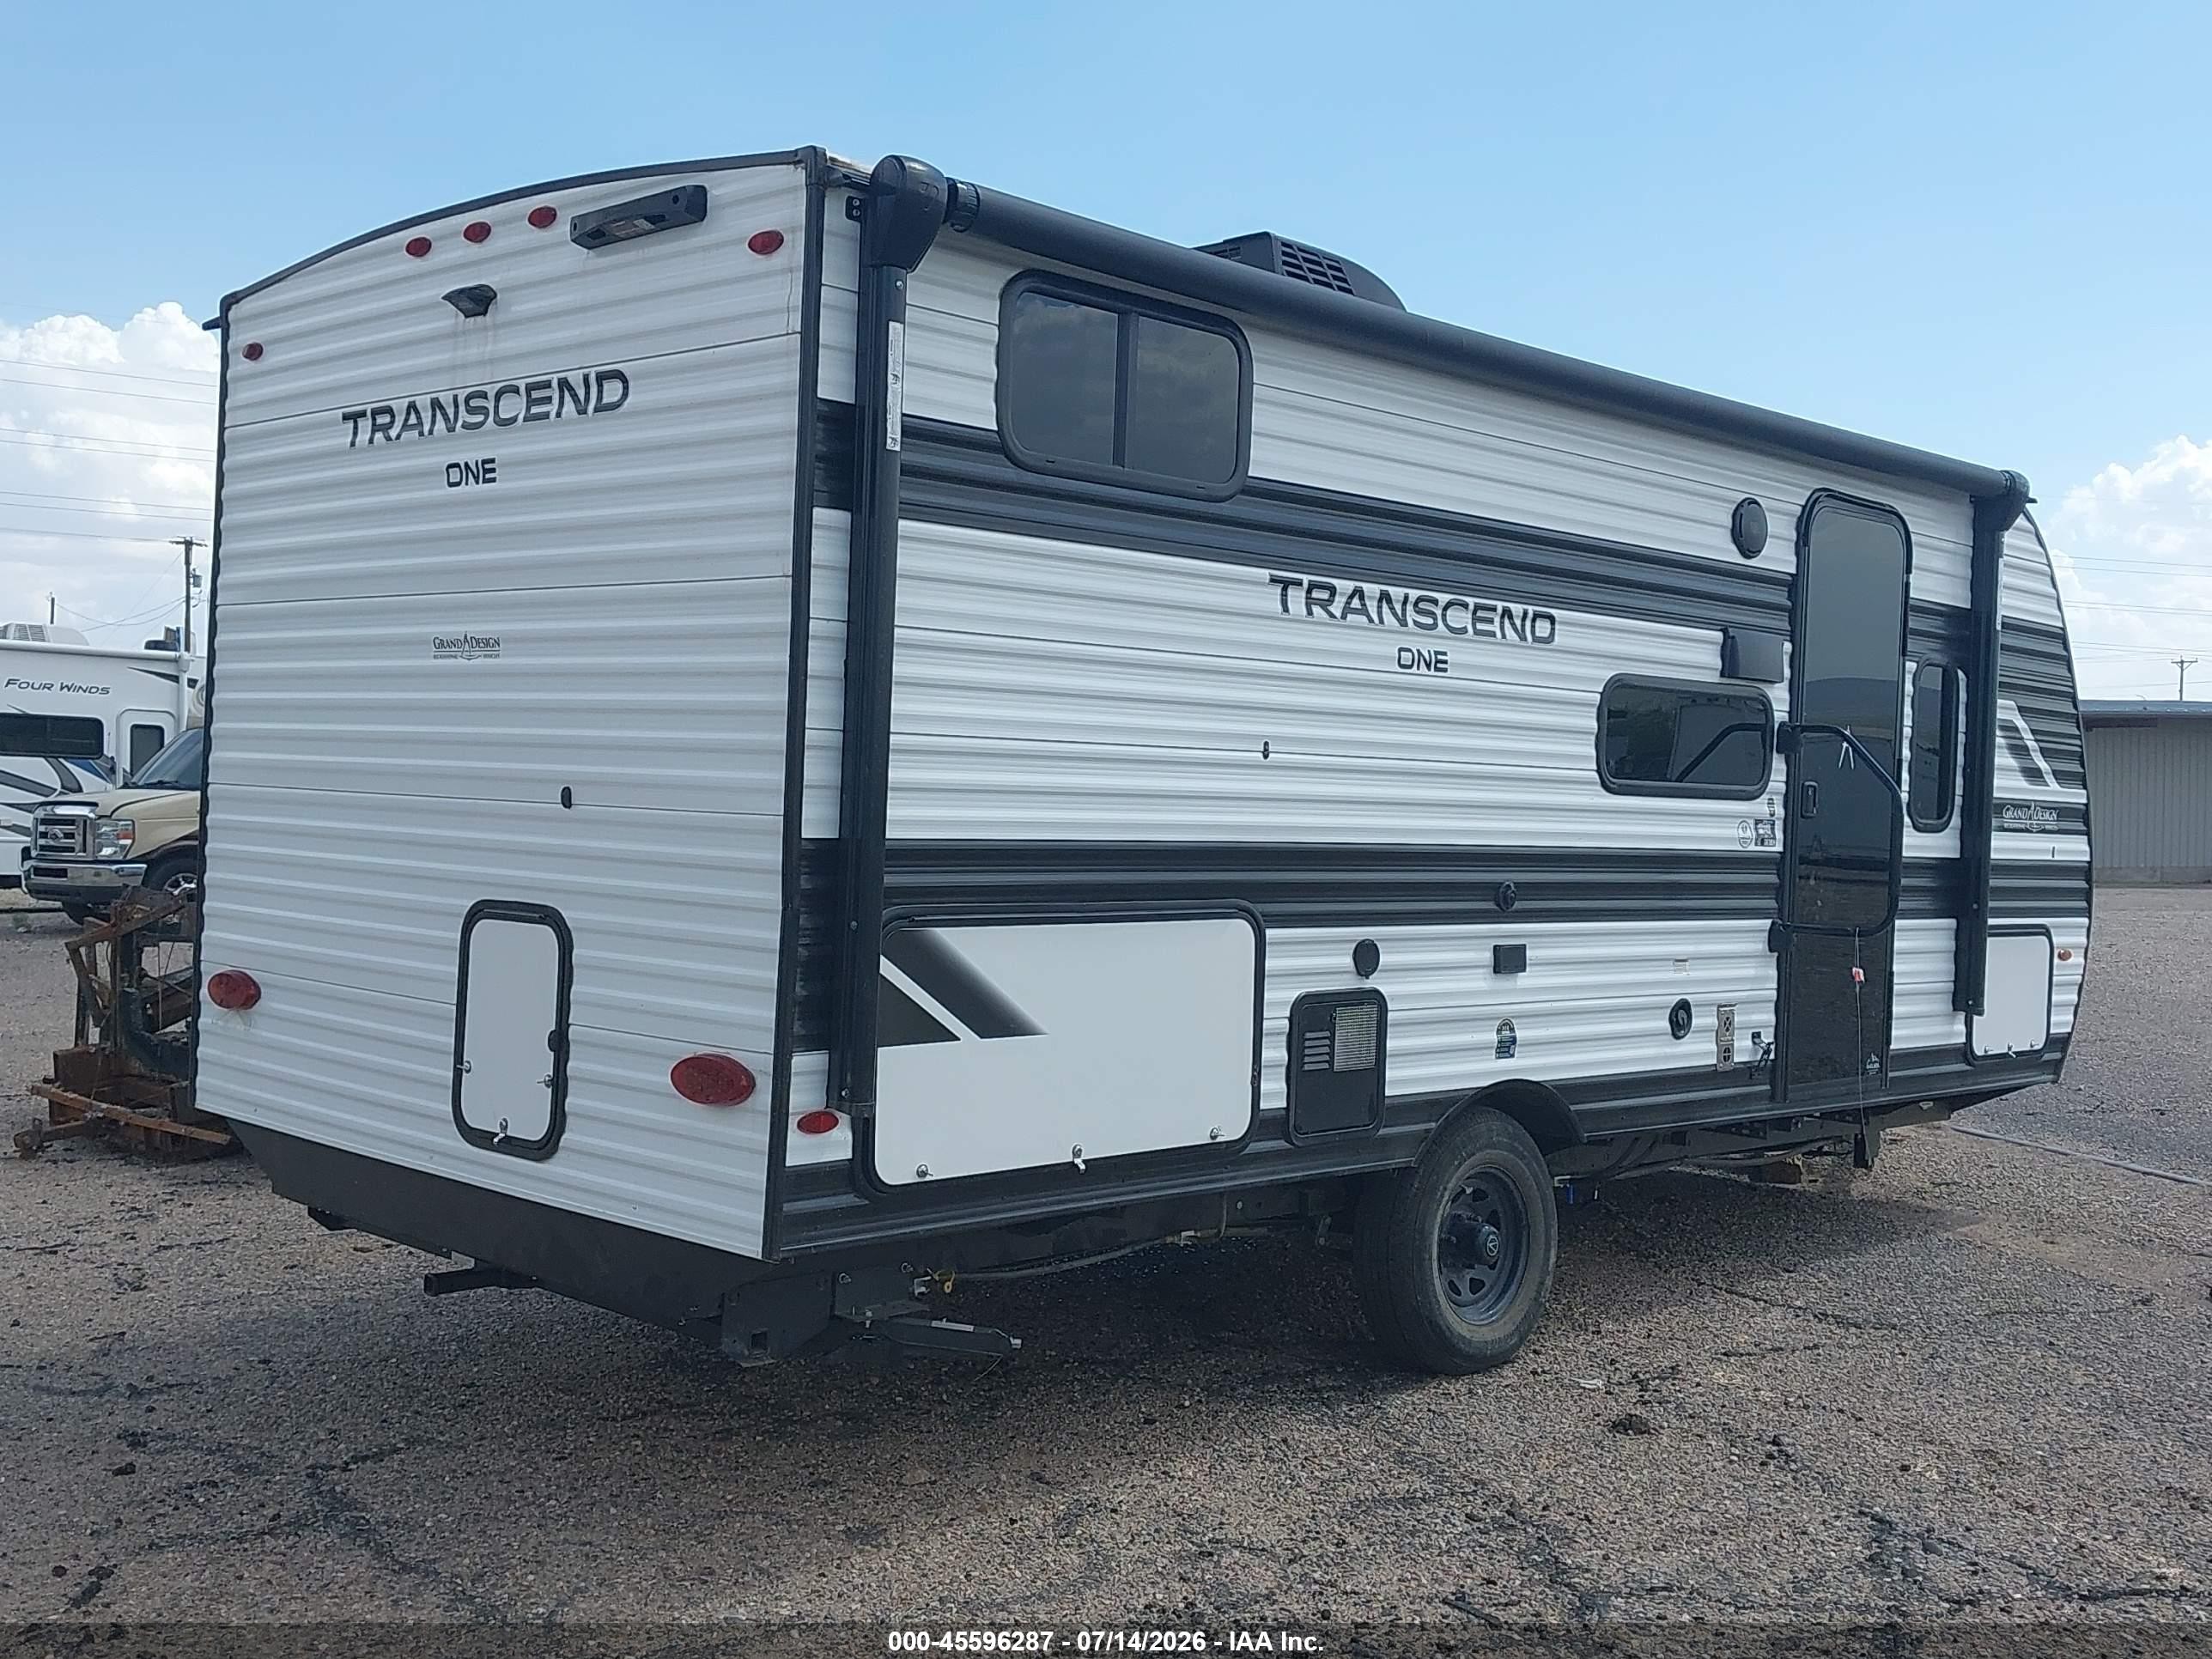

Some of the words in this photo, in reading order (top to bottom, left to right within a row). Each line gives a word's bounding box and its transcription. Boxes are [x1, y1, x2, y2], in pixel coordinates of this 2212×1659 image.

[342, 368, 629, 448] TRANSCEND
[445, 458, 497, 488] ONE
[1268, 573, 1556, 645] TRANSCEND
[433, 636, 463, 650] GRAND
[470, 636, 501, 649] DESIGN
[1397, 647, 1449, 673] ONE
[4, 678, 55, 691] FOUR
[59, 682, 111, 695] WINDS
[2002, 805, 2028, 819] GRAND
[2033, 806, 2059, 821] DESIGN
